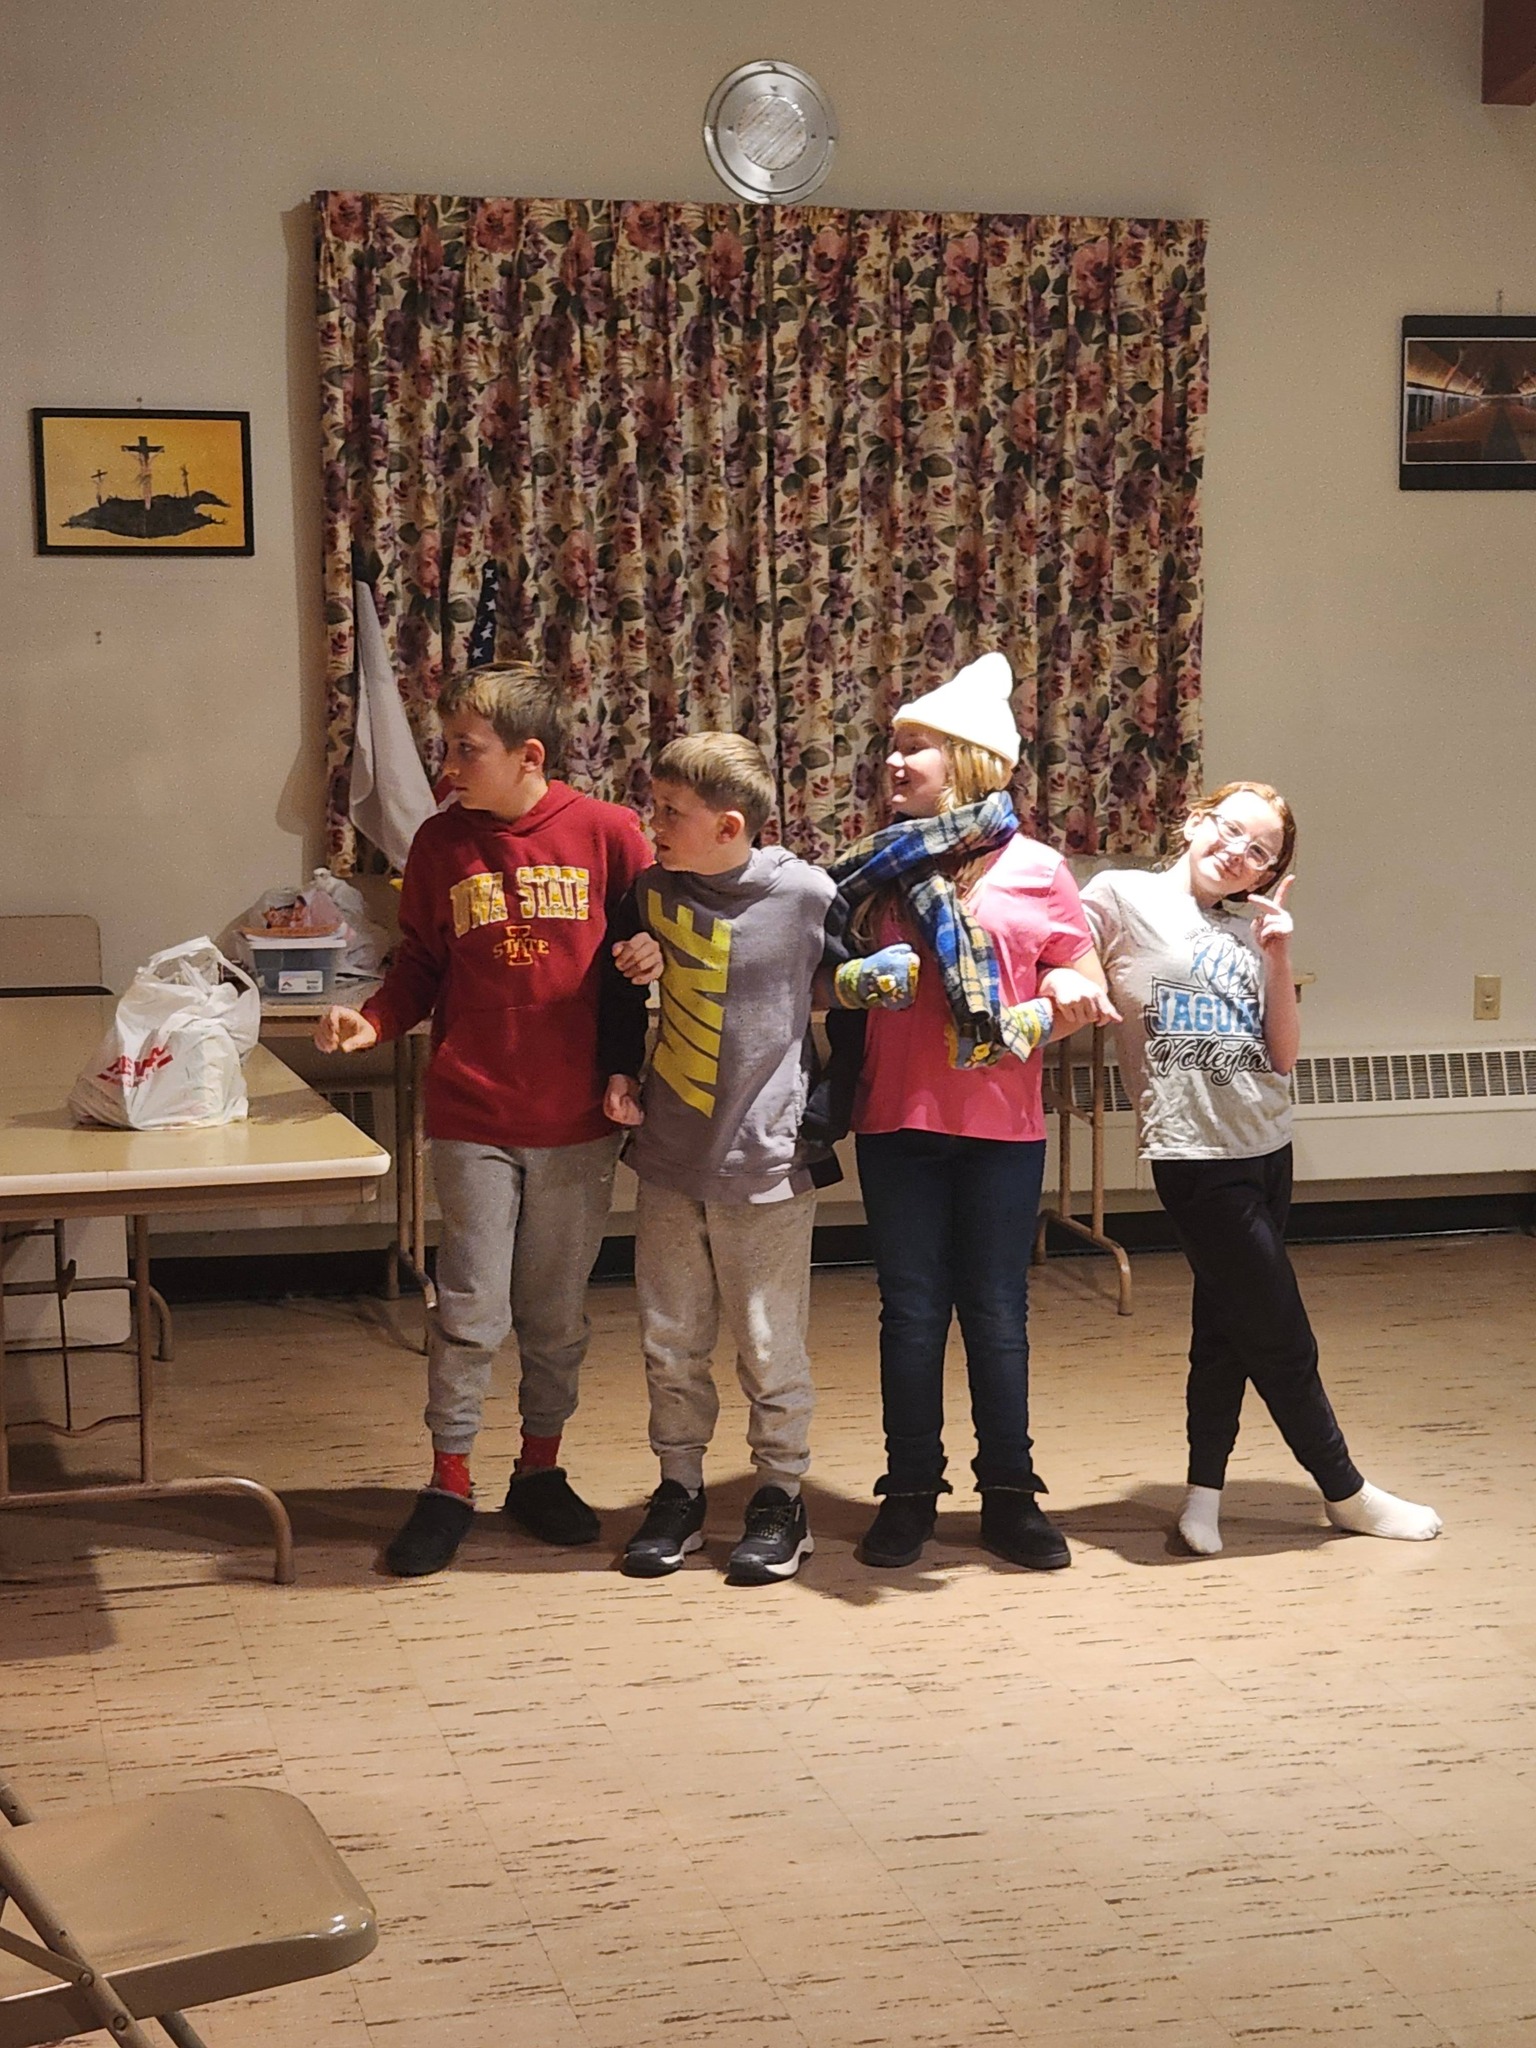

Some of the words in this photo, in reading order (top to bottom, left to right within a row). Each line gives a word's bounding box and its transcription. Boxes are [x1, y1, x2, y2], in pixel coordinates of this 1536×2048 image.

[516, 865, 590, 920] STATE
[493, 938, 550, 959] STATE
[647, 888, 732, 1119] NIKE
